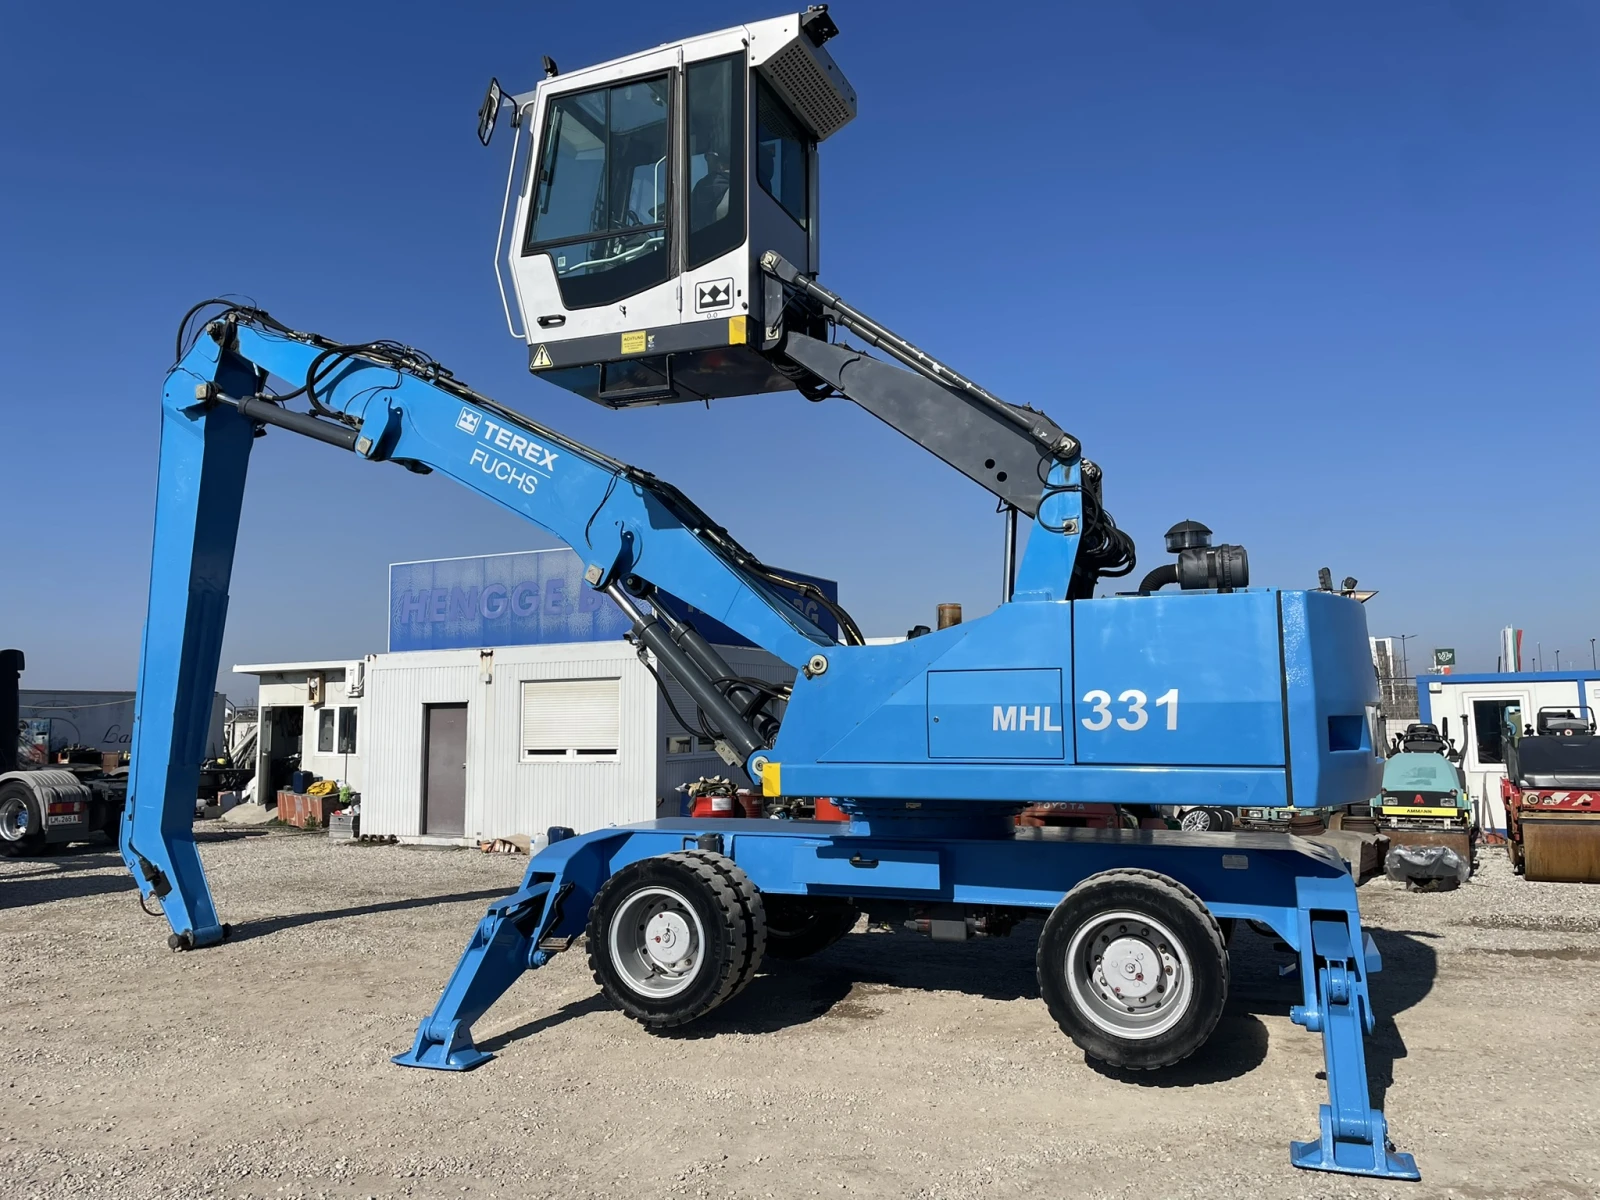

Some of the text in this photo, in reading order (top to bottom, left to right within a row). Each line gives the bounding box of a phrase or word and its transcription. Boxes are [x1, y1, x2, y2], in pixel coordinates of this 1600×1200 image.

[484, 420, 559, 472] TEREX
[469, 448, 538, 494] FUCHS
[992, 688, 1179, 731] MHL 331
[1036, 801, 1085, 810] TOYOTA
